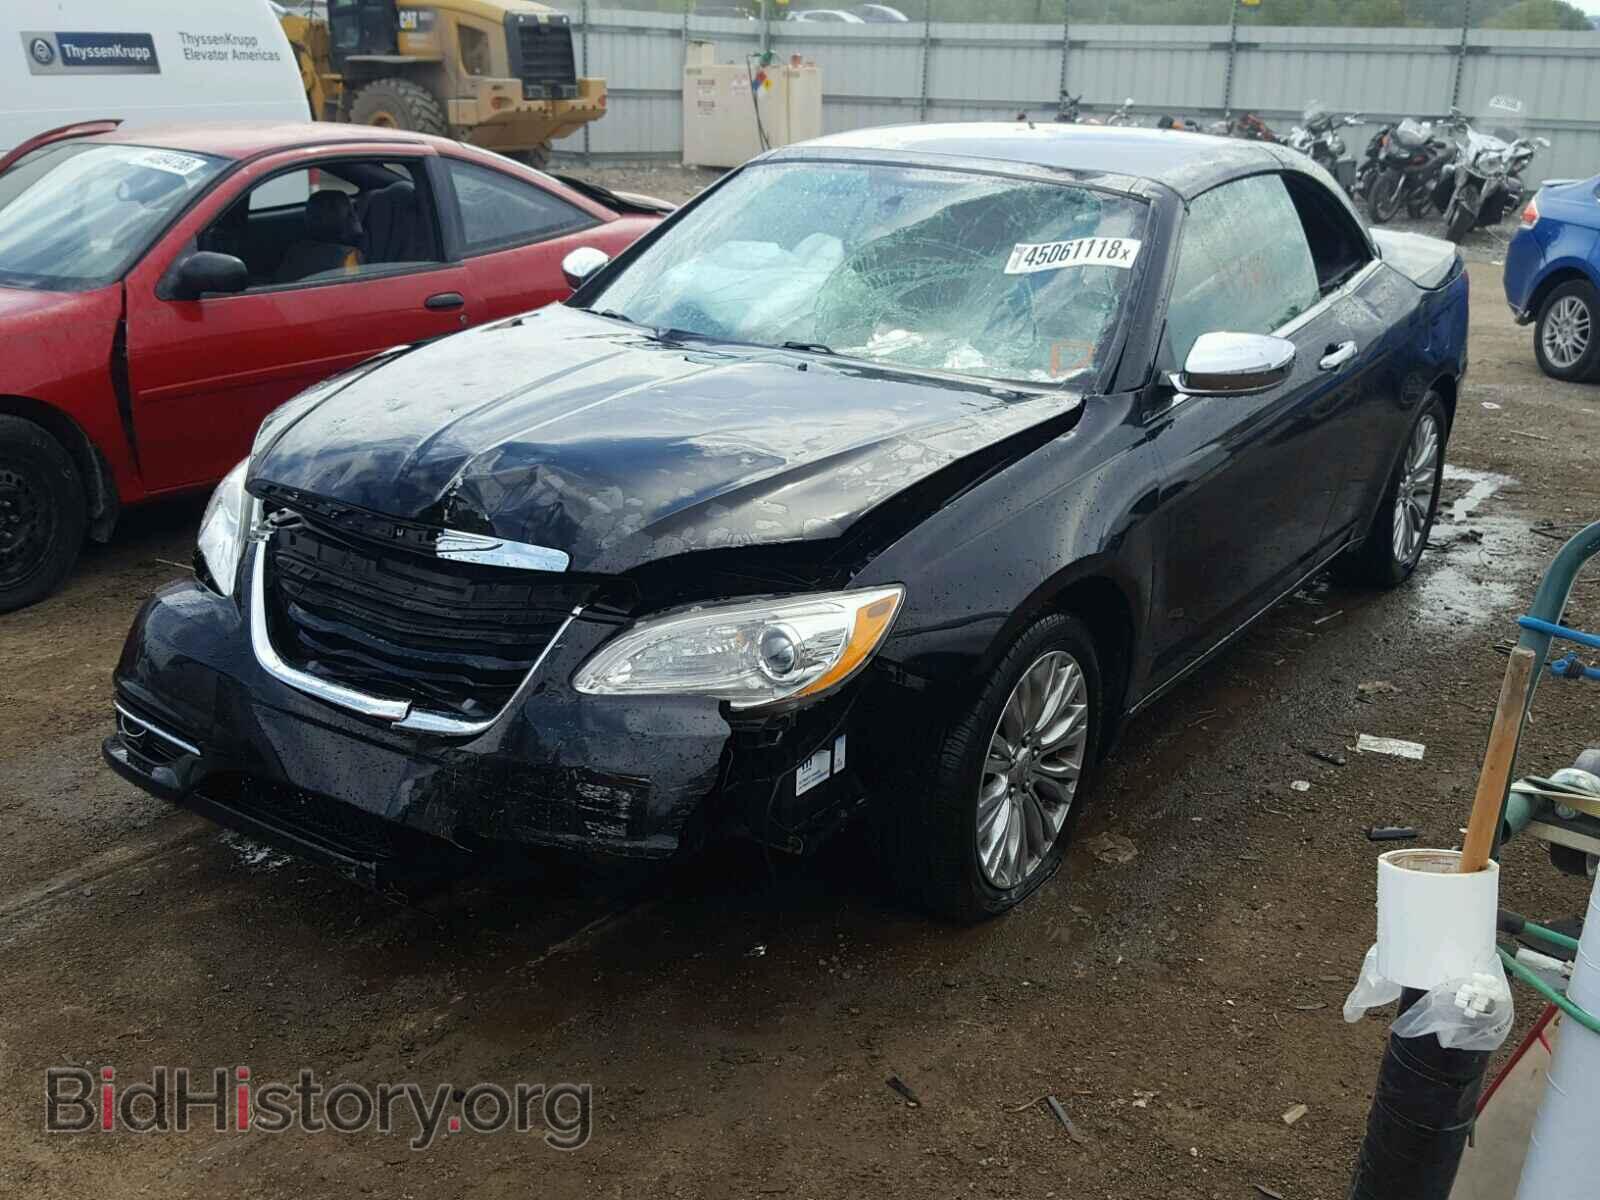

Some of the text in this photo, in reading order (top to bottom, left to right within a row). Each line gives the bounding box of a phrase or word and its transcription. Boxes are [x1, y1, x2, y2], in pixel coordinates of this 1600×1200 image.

[400, 11, 417, 28] CAT
[177, 32, 257, 47] ThyssenKrupp
[61, 43, 151, 61] ThyssenKrupp
[184, 48, 281, 61] Elevator Americas
